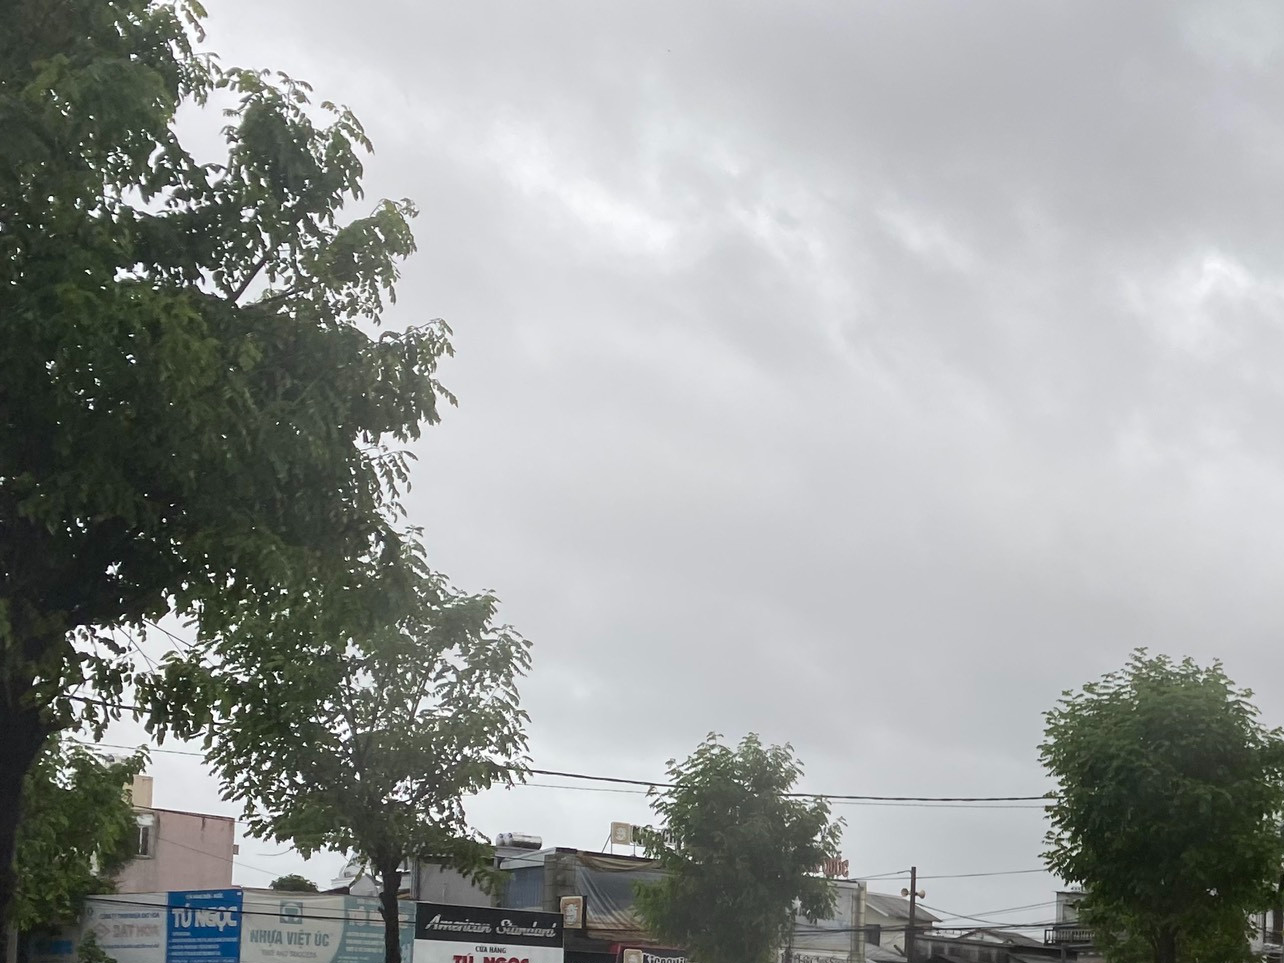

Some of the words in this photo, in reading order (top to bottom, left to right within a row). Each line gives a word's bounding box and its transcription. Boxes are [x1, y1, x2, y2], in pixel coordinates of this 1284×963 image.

[172, 903, 192, 929] TÚ
[425, 914, 492, 934] American
[496, 919, 557, 938] Standard
[250, 929, 283, 946] NHỰA
[286, 929, 311, 948] VIỆT
[314, 929, 330, 947] ÚC
